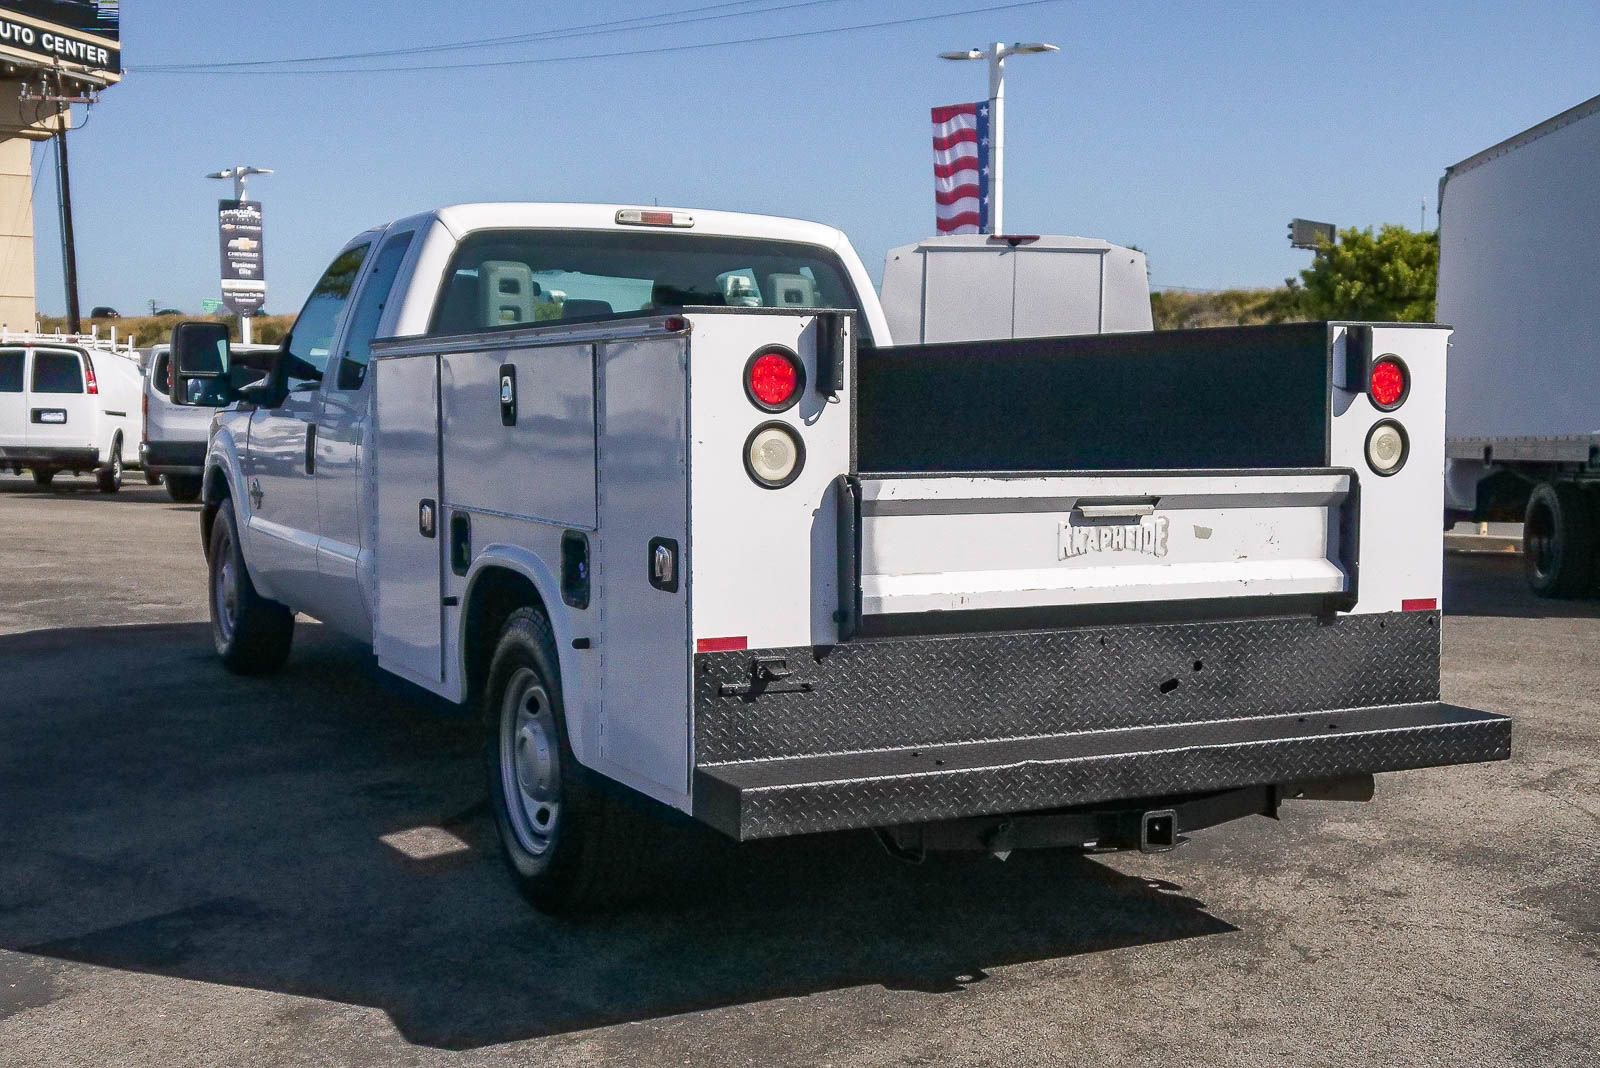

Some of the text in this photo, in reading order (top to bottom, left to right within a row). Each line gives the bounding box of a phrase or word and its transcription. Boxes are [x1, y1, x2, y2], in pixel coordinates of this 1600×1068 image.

[42, 33, 108, 65] CENTER
[231, 261, 257, 269] Business
[1057, 516, 1170, 562] KNAPHEIDE
